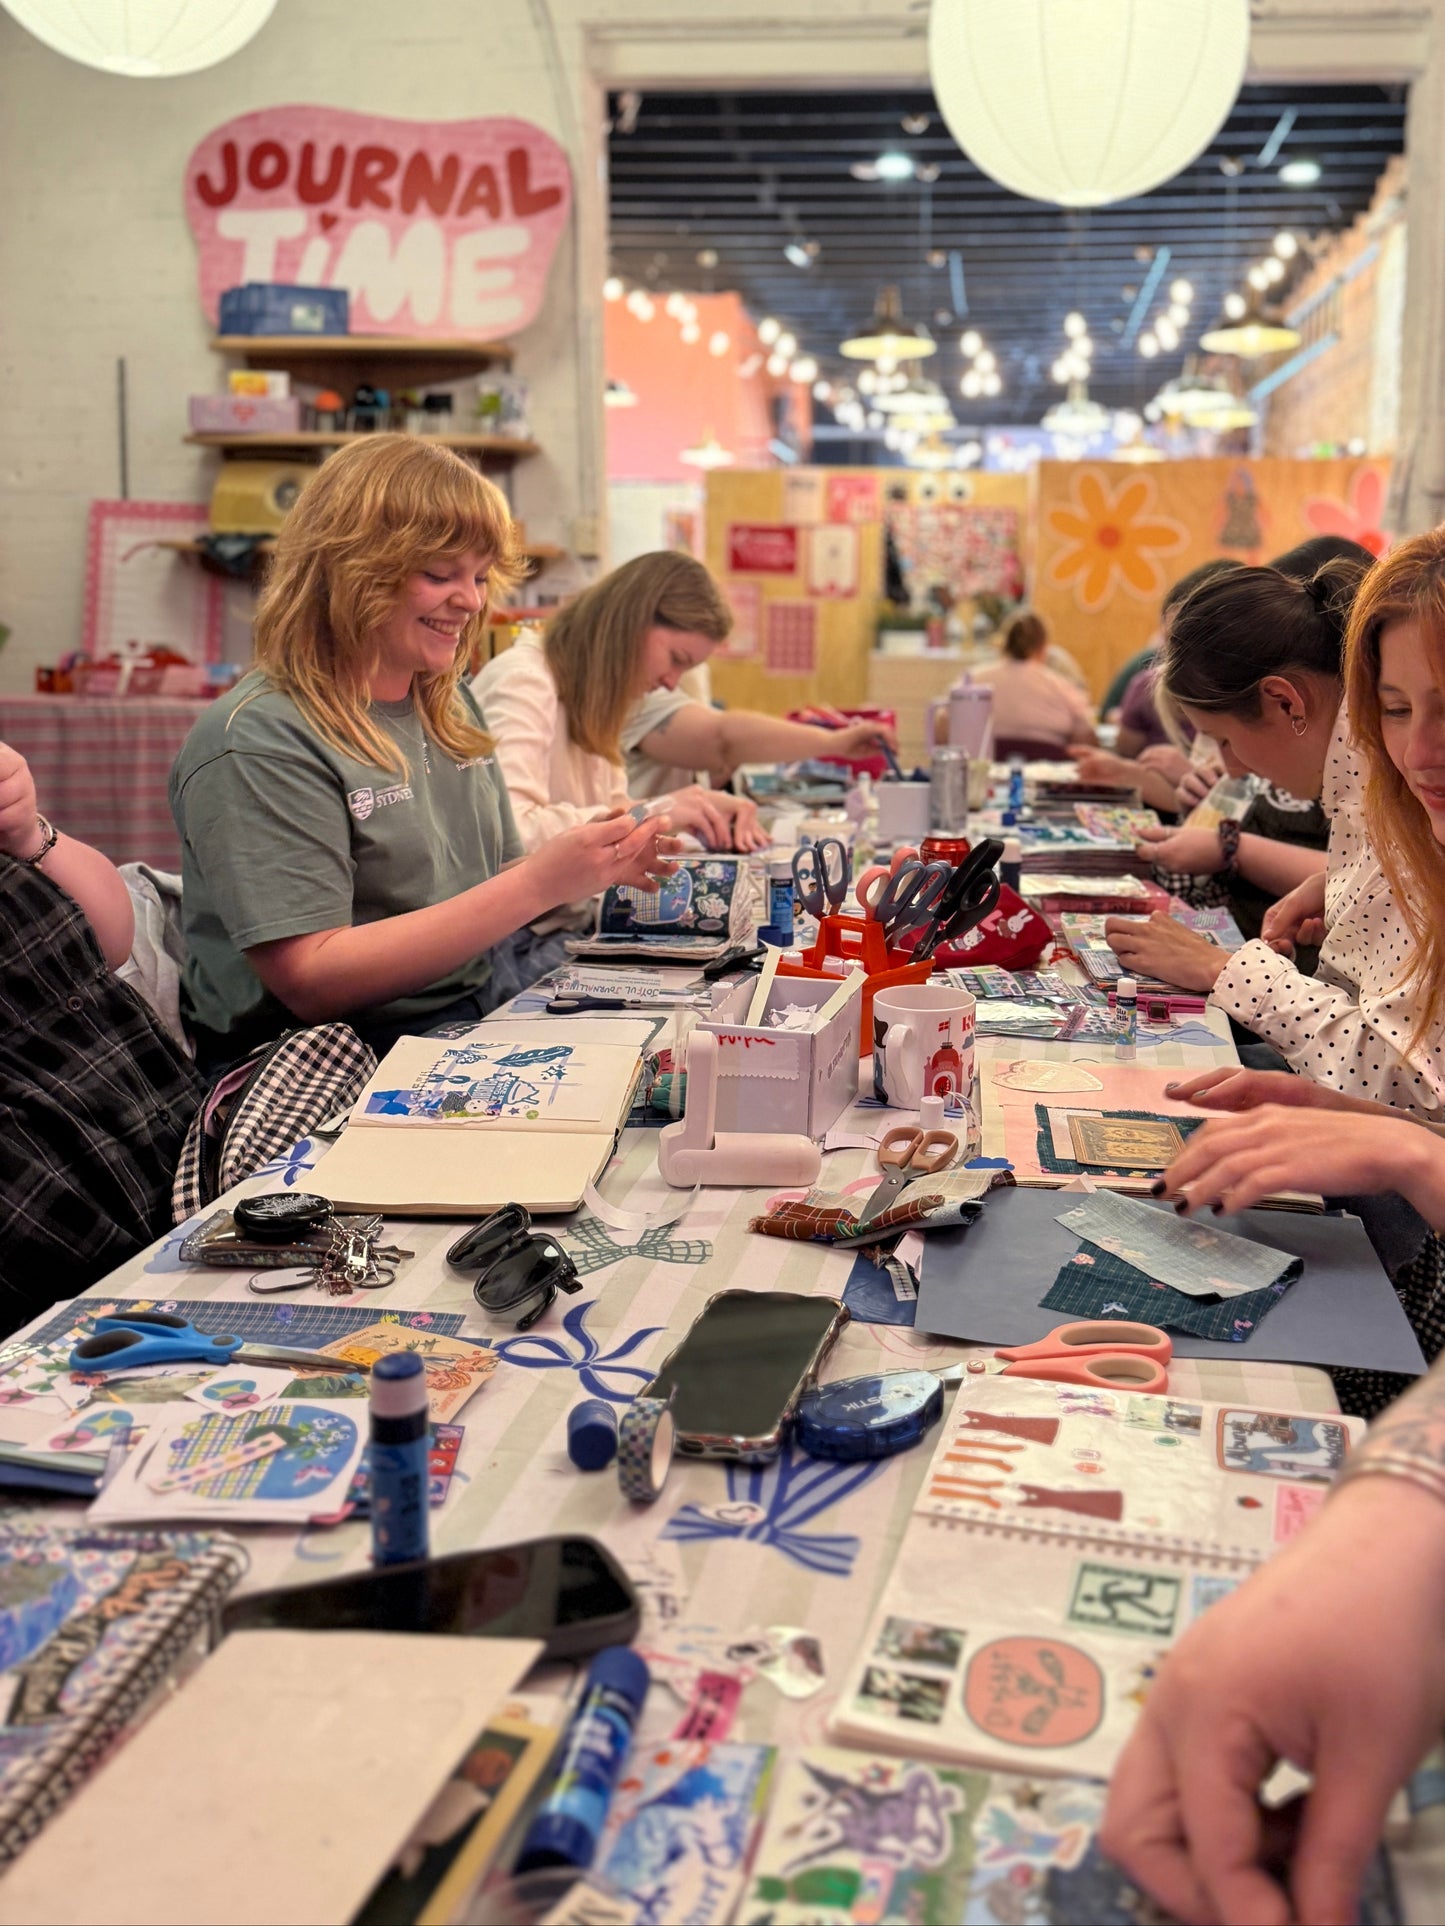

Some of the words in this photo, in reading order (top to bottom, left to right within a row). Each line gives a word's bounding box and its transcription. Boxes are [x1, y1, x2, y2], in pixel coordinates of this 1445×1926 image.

[195, 139, 563, 221] JOURNAL
[564, 981, 622, 995] JOURNALLING
[625, 986, 659, 998] JOYFUL
